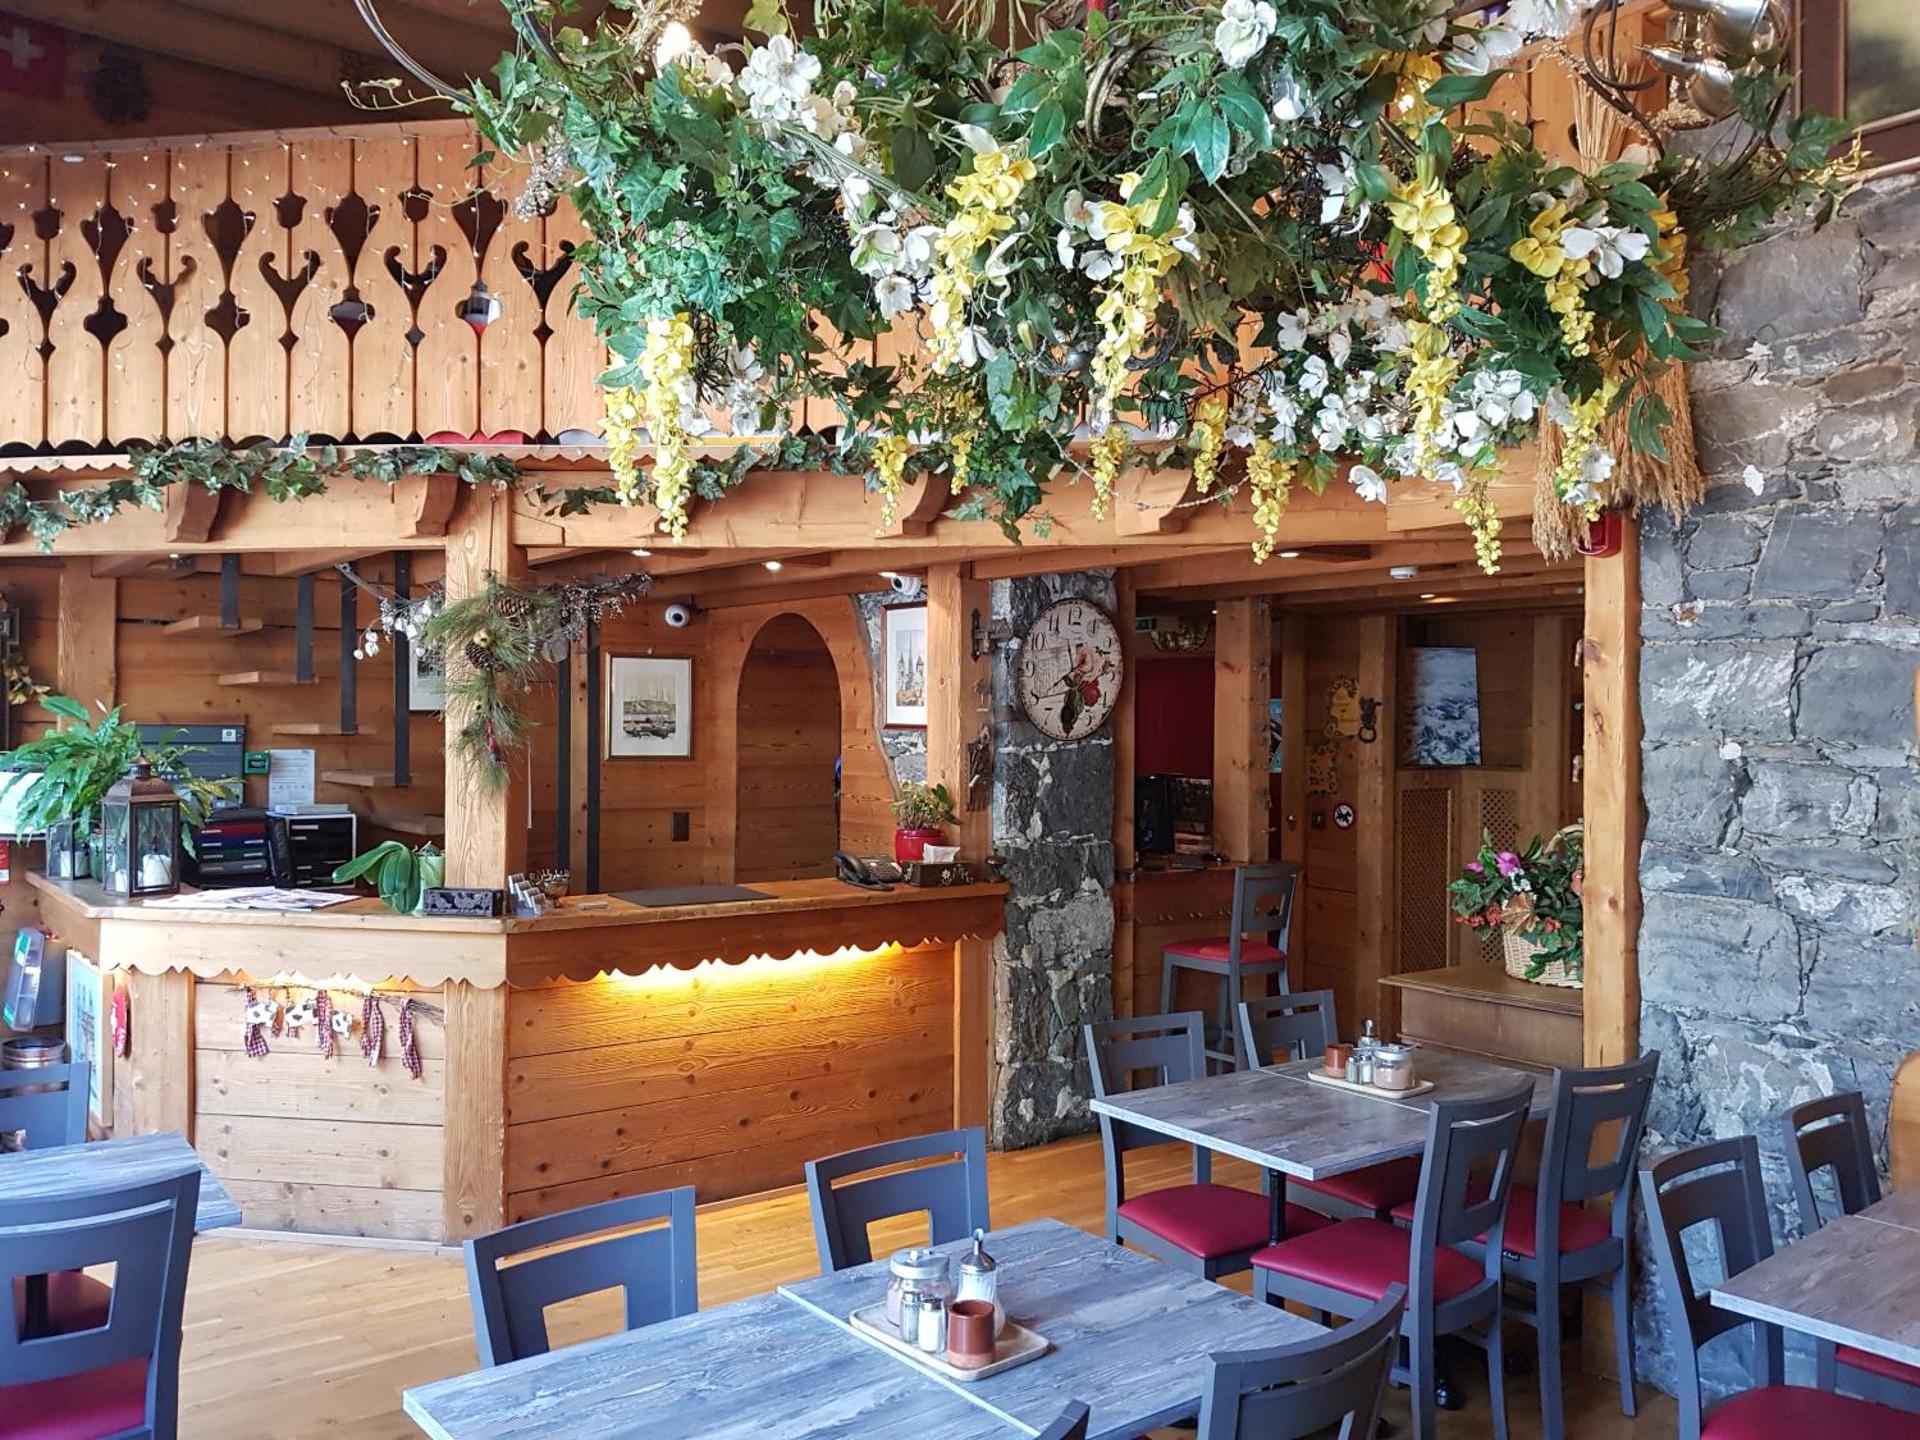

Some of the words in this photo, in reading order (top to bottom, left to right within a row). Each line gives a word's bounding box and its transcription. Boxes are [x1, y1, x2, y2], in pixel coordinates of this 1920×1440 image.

[1050, 614, 1060, 635] 11
[1068, 606, 1082, 625] 12
[1030, 632, 1045, 651] 10
[1026, 660, 1035, 677] 9
[1044, 707, 1053, 726] 7
